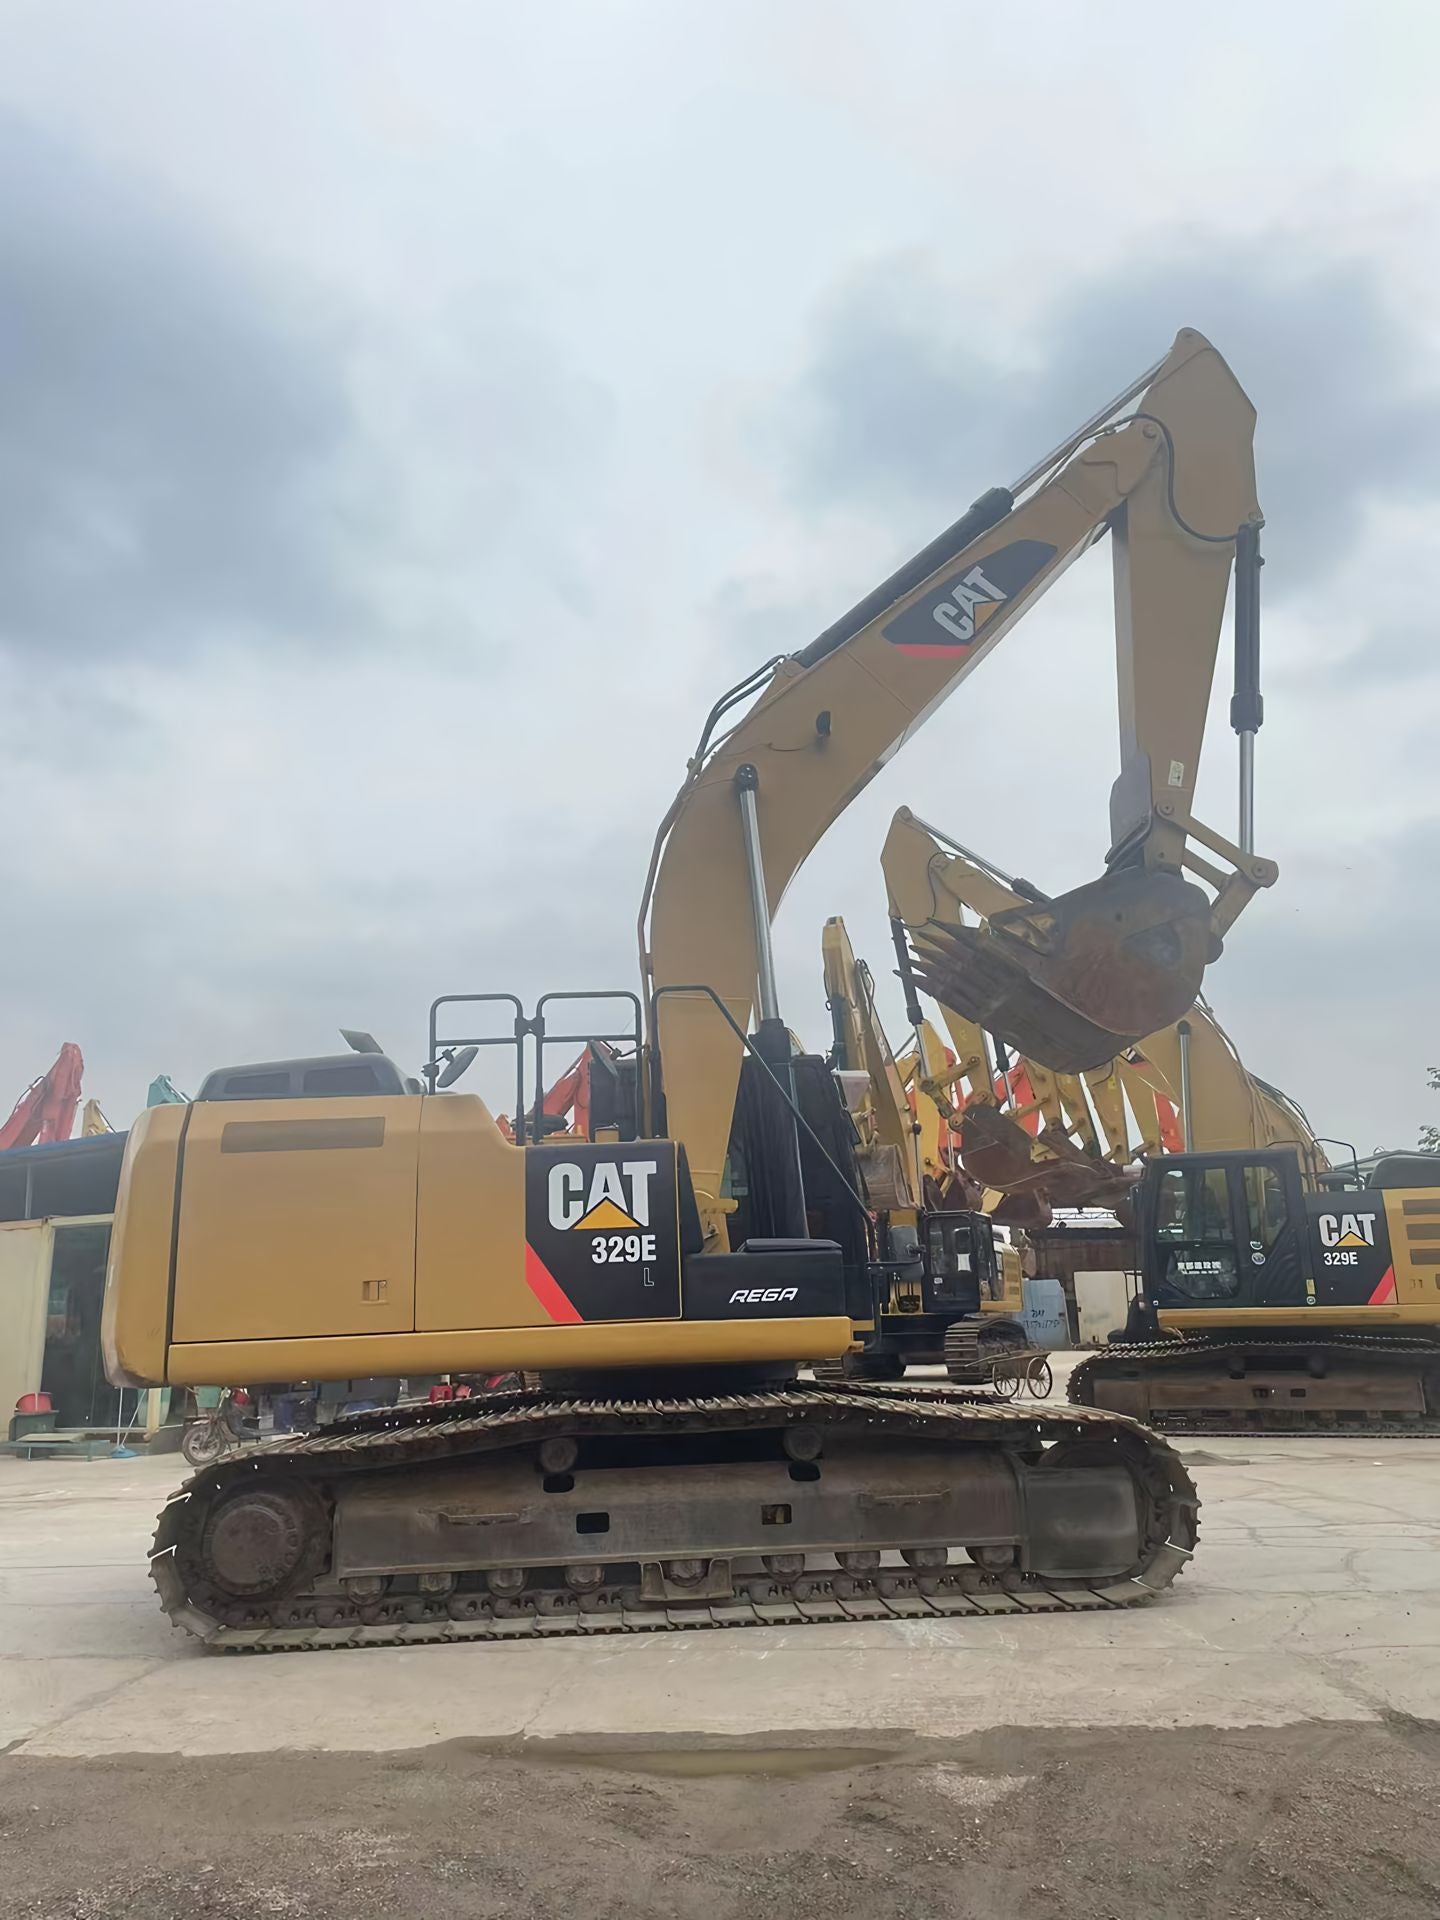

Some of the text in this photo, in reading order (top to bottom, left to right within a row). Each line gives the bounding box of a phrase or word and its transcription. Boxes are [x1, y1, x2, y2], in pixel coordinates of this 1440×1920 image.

[933, 566, 1008, 640] CAT
[548, 1161, 657, 1231] CAT
[1319, 1213, 1376, 1247] CAT
[591, 1234, 657, 1264] 329E
[1323, 1251, 1359, 1266] 329E
[729, 1287, 799, 1304] REGA
